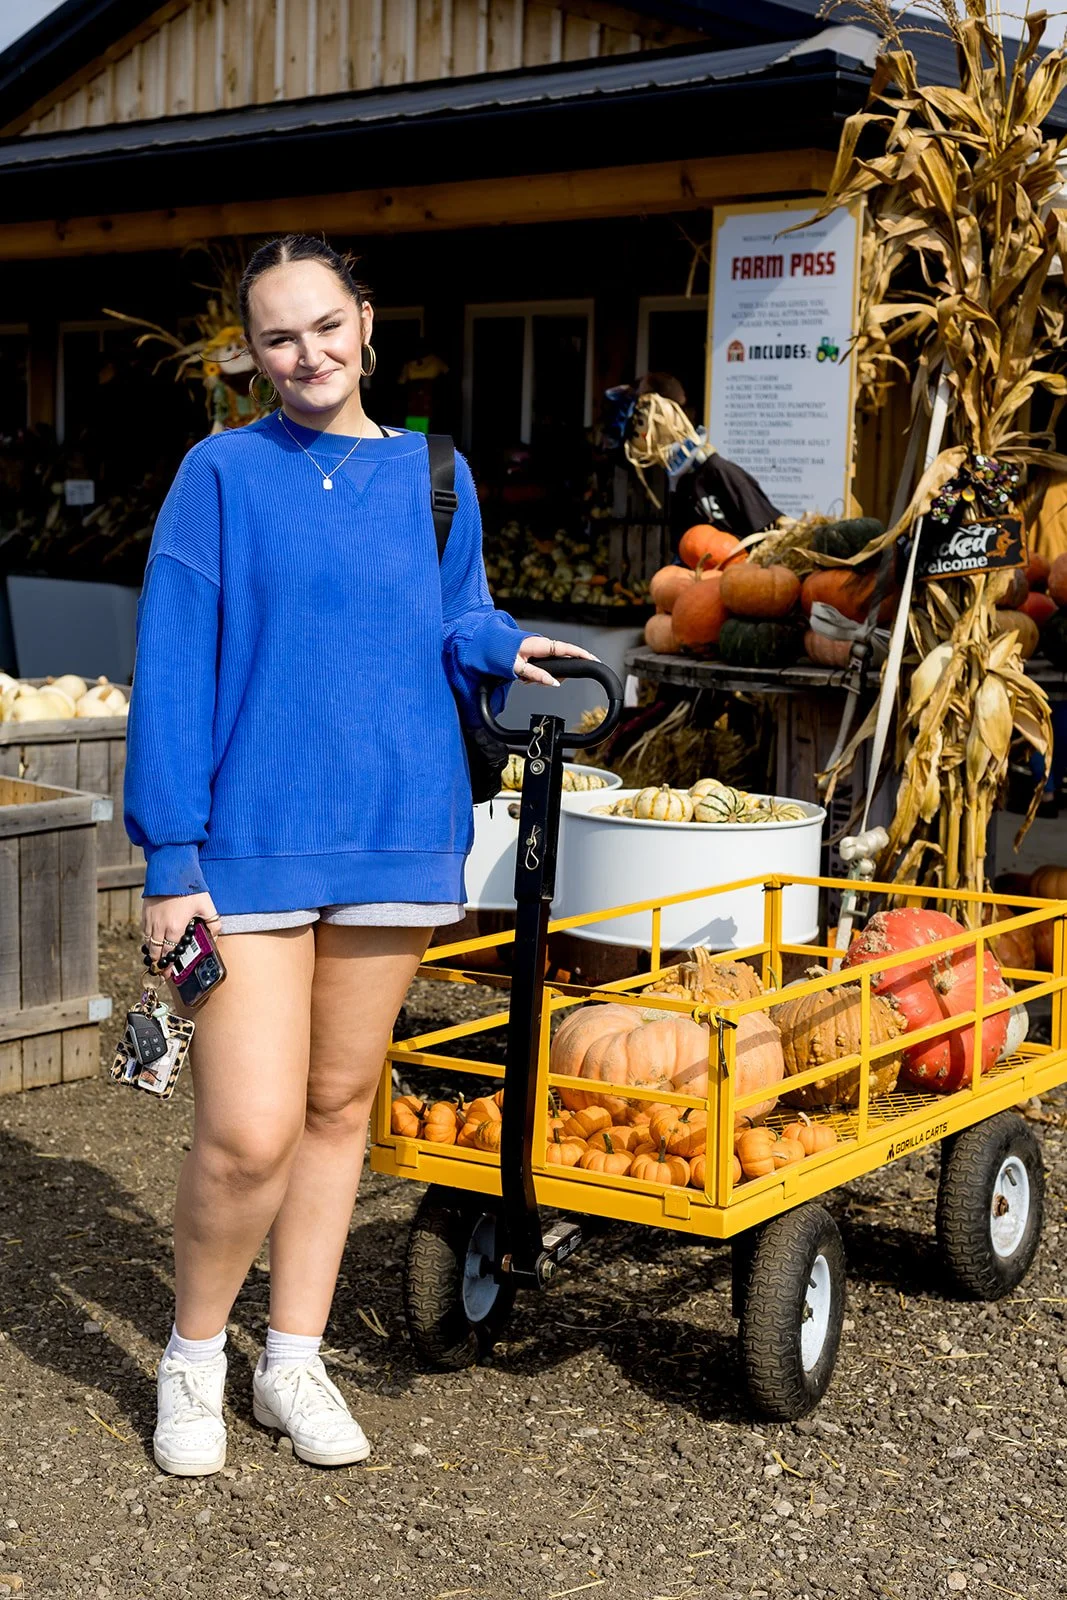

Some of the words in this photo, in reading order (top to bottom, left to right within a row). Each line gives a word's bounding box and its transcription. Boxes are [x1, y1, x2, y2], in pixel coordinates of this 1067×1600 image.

[732, 255, 783, 280] FARM
[791, 251, 836, 277] PASS
[768, 310, 780, 318] ALL
[749, 344, 811, 360] INCLUDES:
[896, 1133, 924, 1154] GORILLA
[925, 1121, 948, 1141] CARTS
